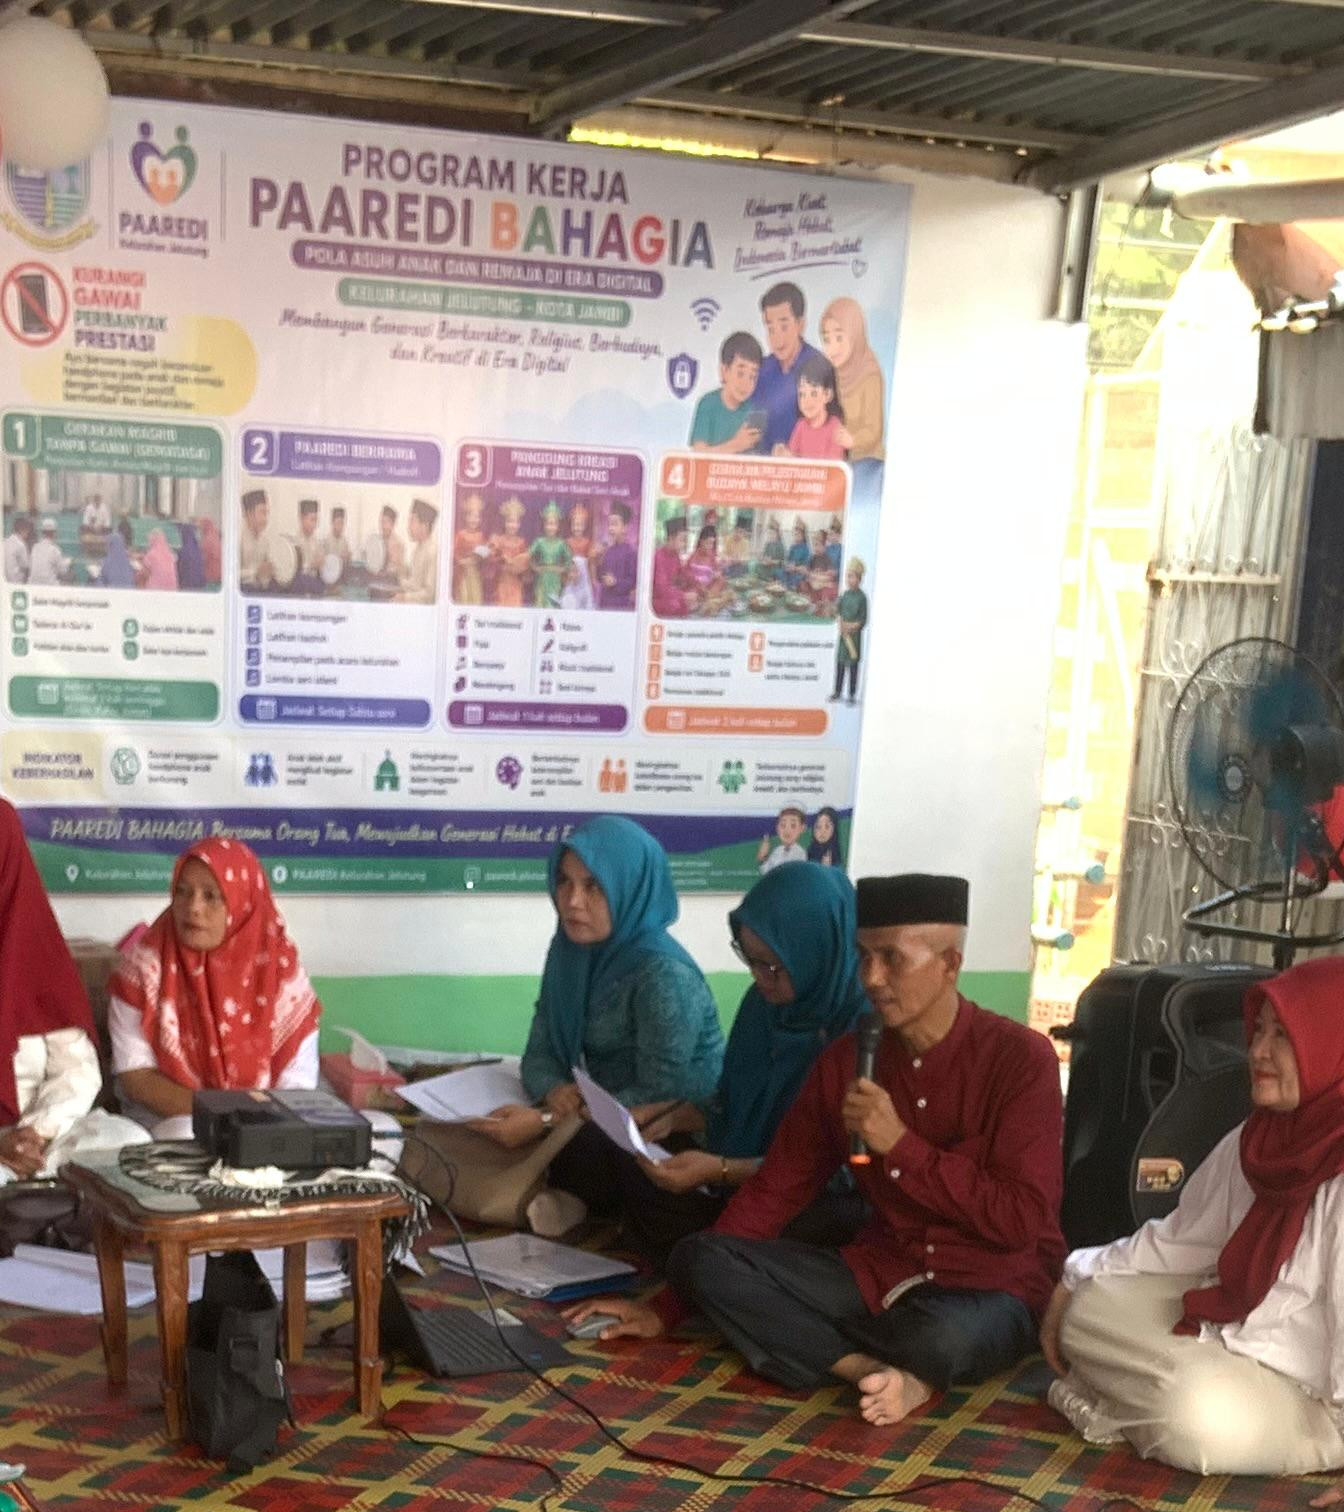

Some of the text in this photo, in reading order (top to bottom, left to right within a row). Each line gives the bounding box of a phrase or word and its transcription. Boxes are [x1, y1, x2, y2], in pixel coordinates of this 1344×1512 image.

[342, 143, 630, 206] PROGRAM KERJA
[119, 211, 209, 241] PAAREDI
[250, 177, 715, 270] PAAREDI BAHAGIA
[305, 245, 349, 265] POLA
[72, 266, 147, 288] KURANGI
[72, 287, 143, 311] GAWAI
[74, 328, 156, 352] PRESTASI
[12, 419, 26, 450] 1
[250, 436, 269, 466] 2
[464, 450, 483, 479] 3
[666, 462, 685, 490] 4
[50, 819, 124, 840] PAAREDI
[128, 819, 204, 841] BAHAGIA
